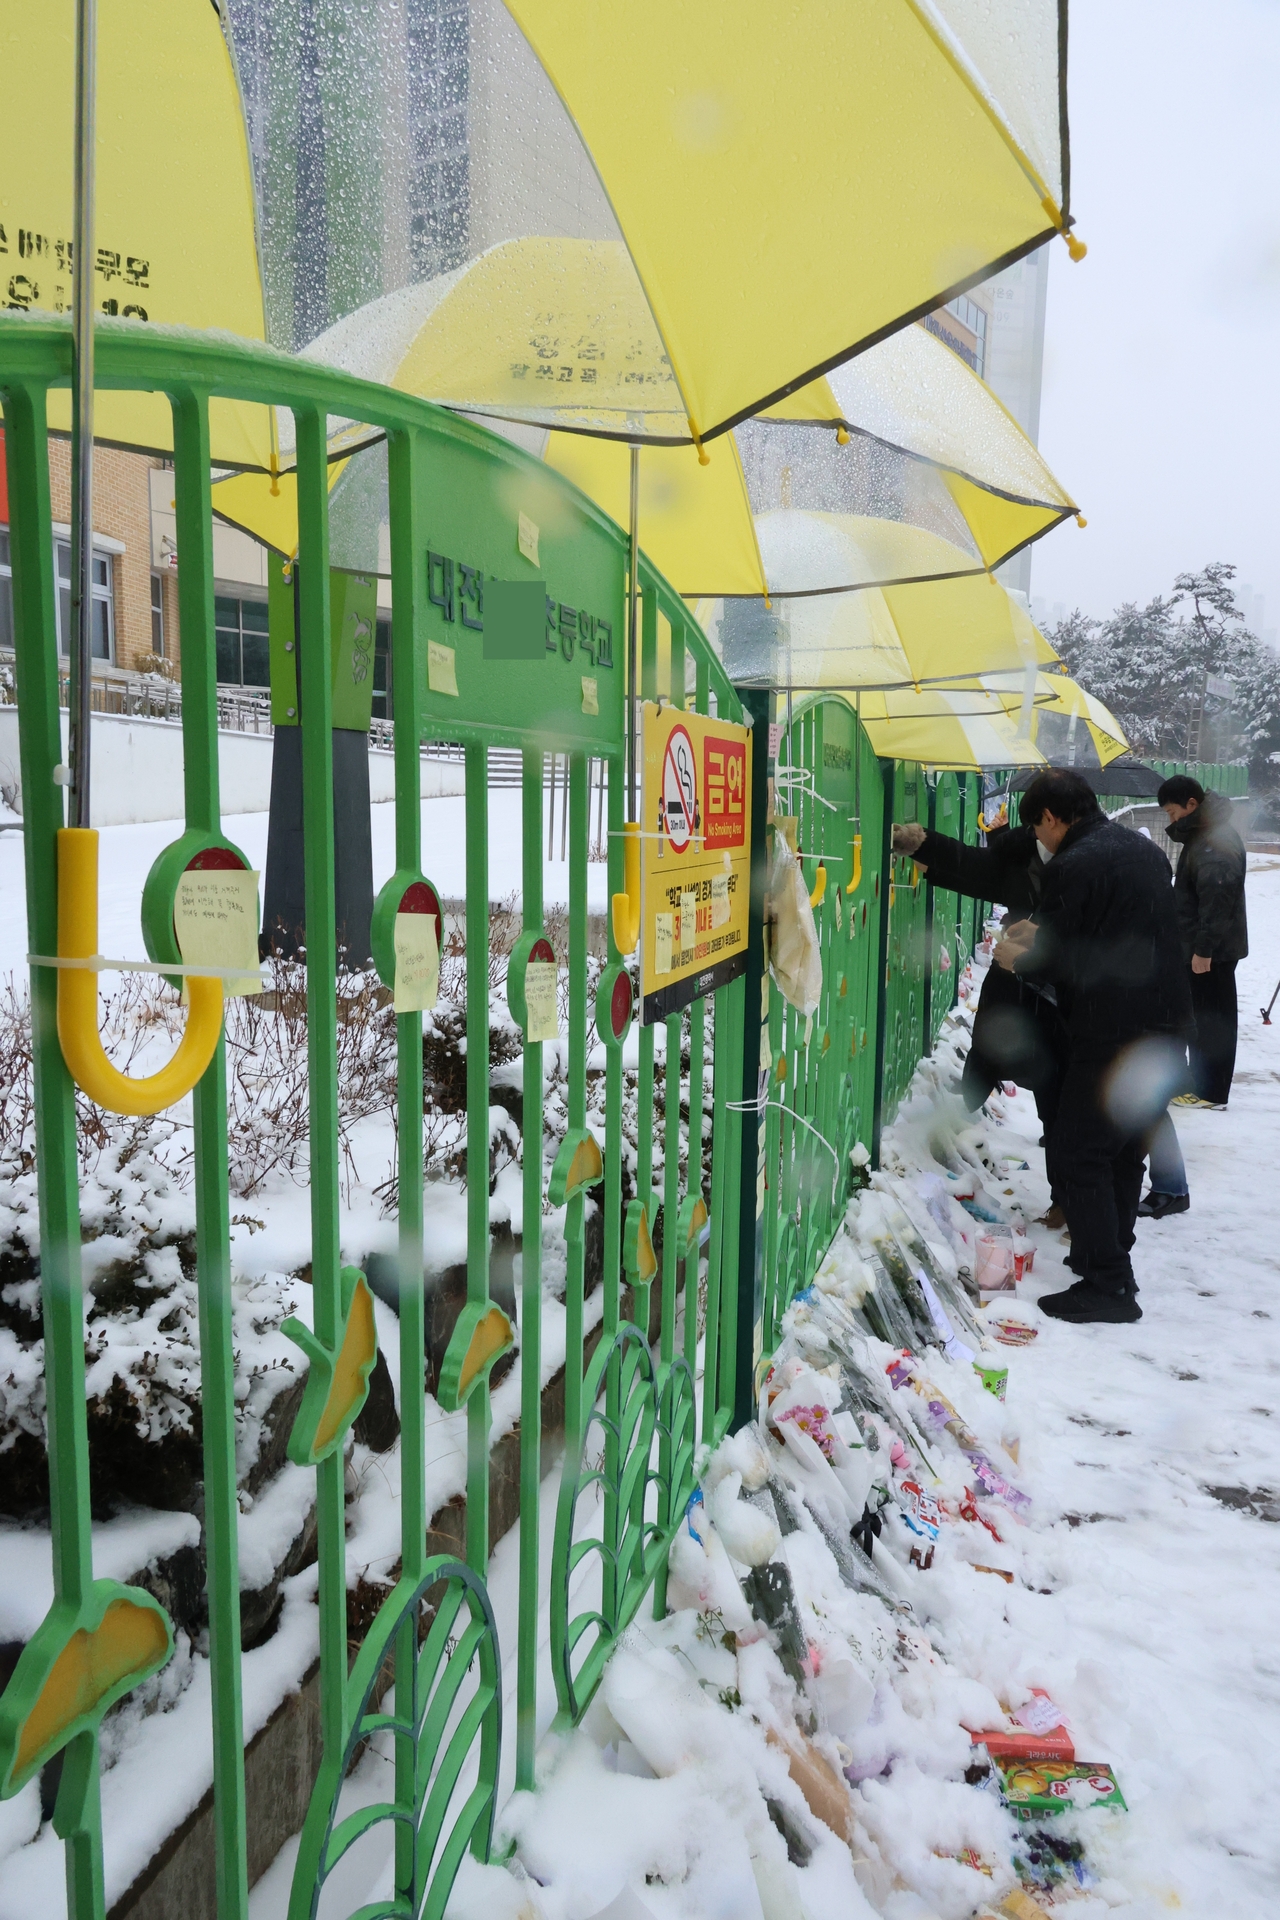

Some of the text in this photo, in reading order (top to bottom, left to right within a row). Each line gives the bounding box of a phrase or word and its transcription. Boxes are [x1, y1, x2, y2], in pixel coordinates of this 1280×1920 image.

[708, 752, 743, 814] 금연
[708, 822, 742, 839] No Smoking Area
